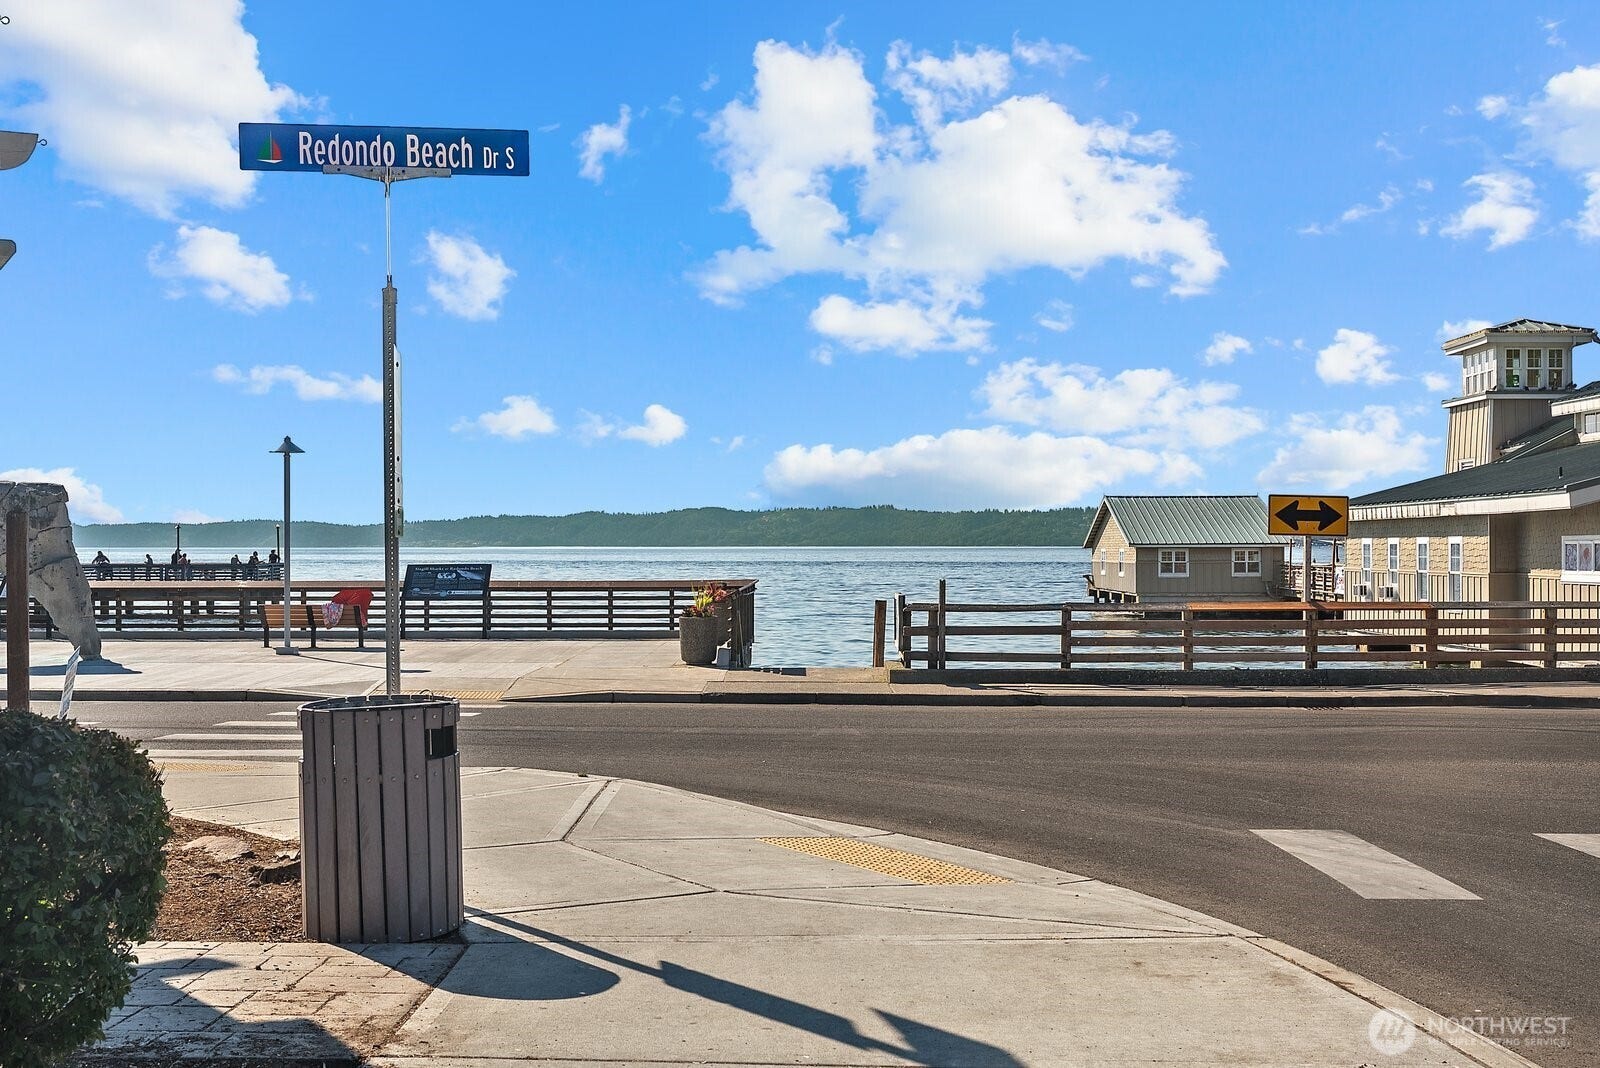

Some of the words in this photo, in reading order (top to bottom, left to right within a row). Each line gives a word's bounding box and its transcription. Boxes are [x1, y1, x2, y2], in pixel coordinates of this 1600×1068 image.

[298, 131, 396, 168] Redondo
[406, 134, 473, 169] Beach
[483, 146, 499, 169] Dr
[506, 146, 514, 170] S
